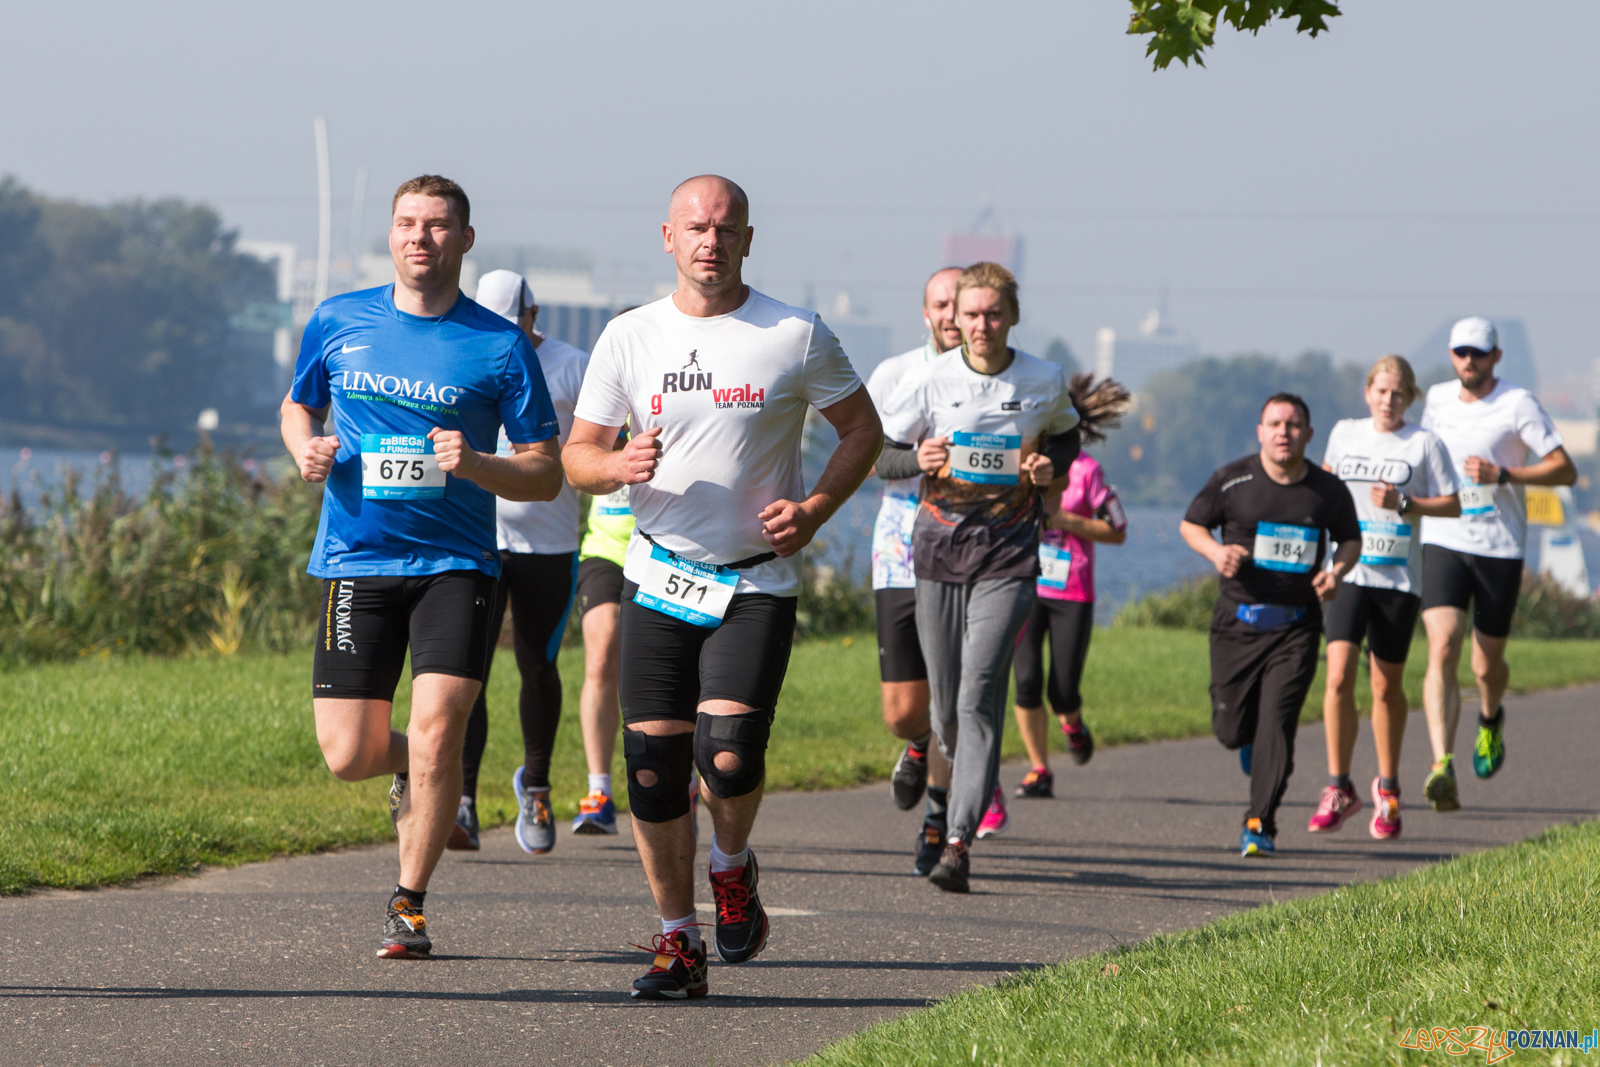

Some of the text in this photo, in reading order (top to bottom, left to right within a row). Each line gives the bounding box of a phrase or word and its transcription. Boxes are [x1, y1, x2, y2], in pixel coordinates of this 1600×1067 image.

[397, 399, 419, 409] przez
[379, 436, 426, 449] zaBIEGaj
[386, 445, 425, 454] FUNdusze
[968, 451, 1004, 470] 655
[379, 459, 425, 481] 675
[1273, 541, 1303, 558] 184
[1366, 537, 1396, 553] 307
[678, 561, 716, 580] FUNdusze
[665, 573, 708, 605] 571
